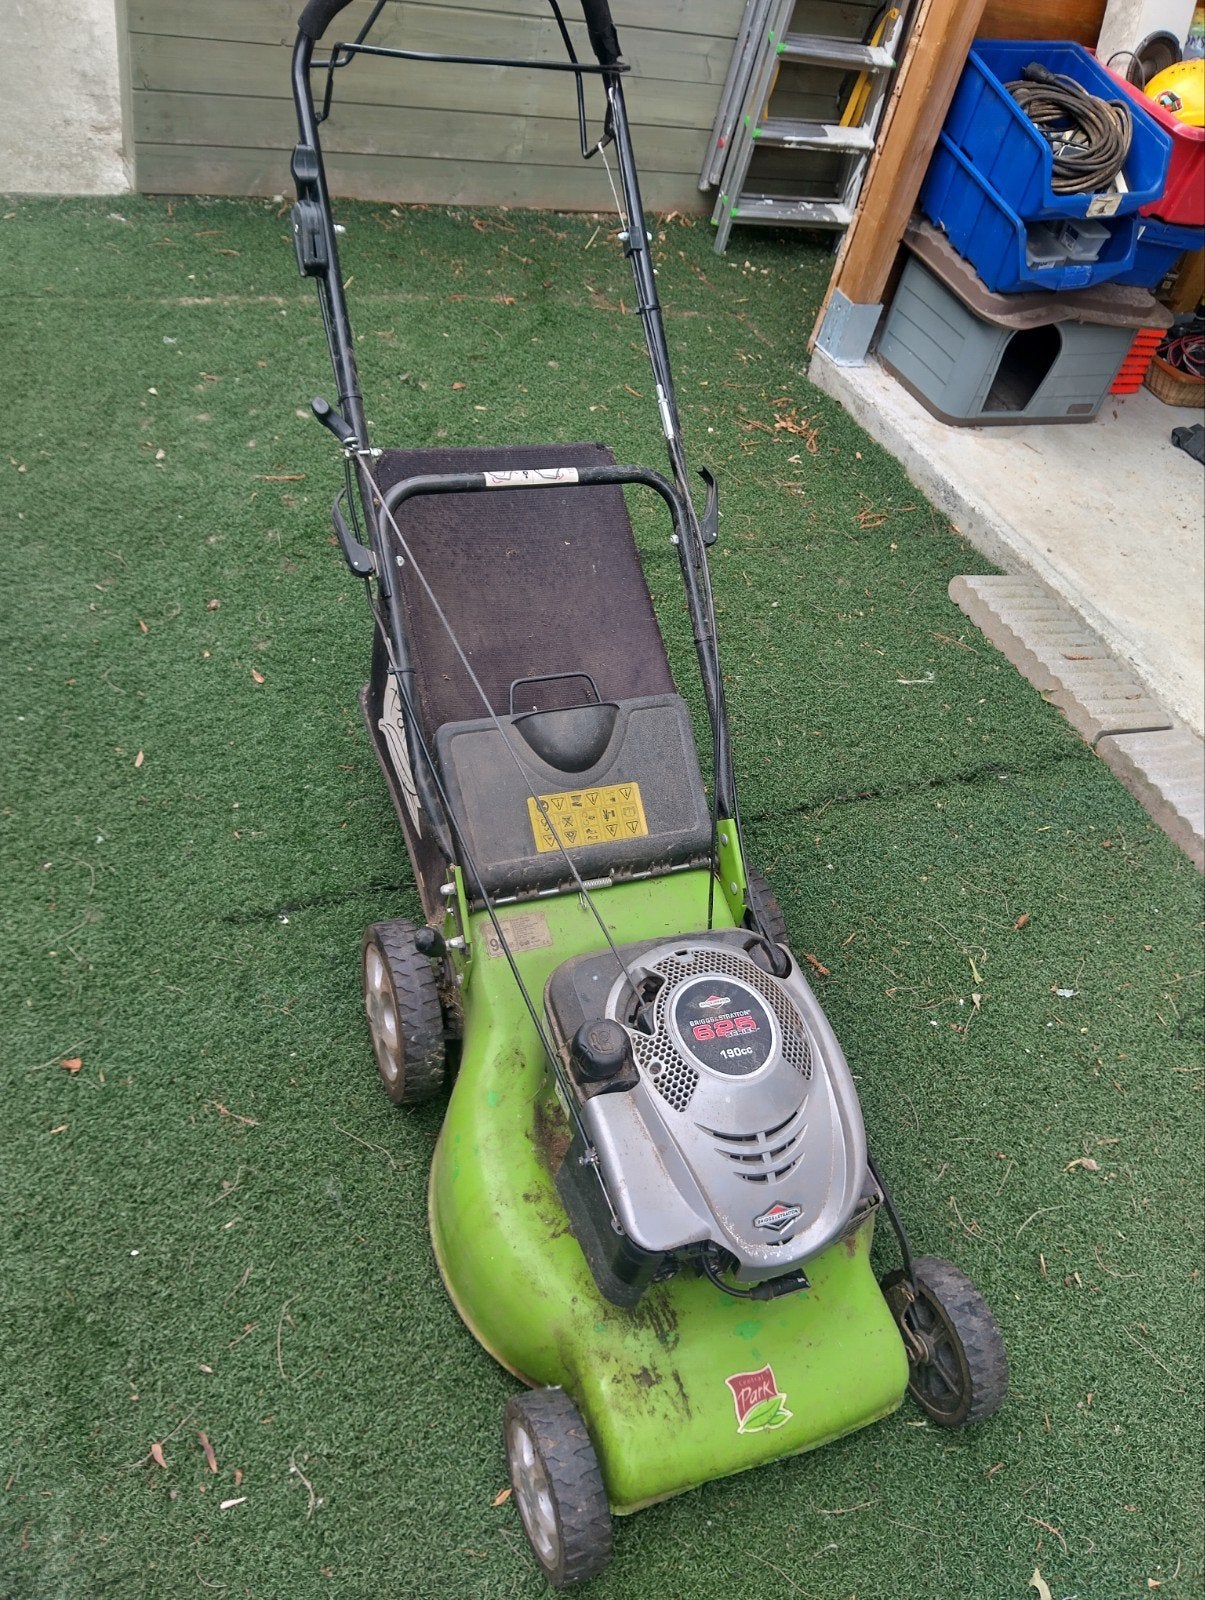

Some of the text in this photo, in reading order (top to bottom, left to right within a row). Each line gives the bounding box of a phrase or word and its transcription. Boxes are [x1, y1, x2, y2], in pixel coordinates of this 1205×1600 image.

[693, 1015, 757, 1041] 625
[720, 1046, 753, 1059] 190cc
[737, 1380, 775, 1412] Park
